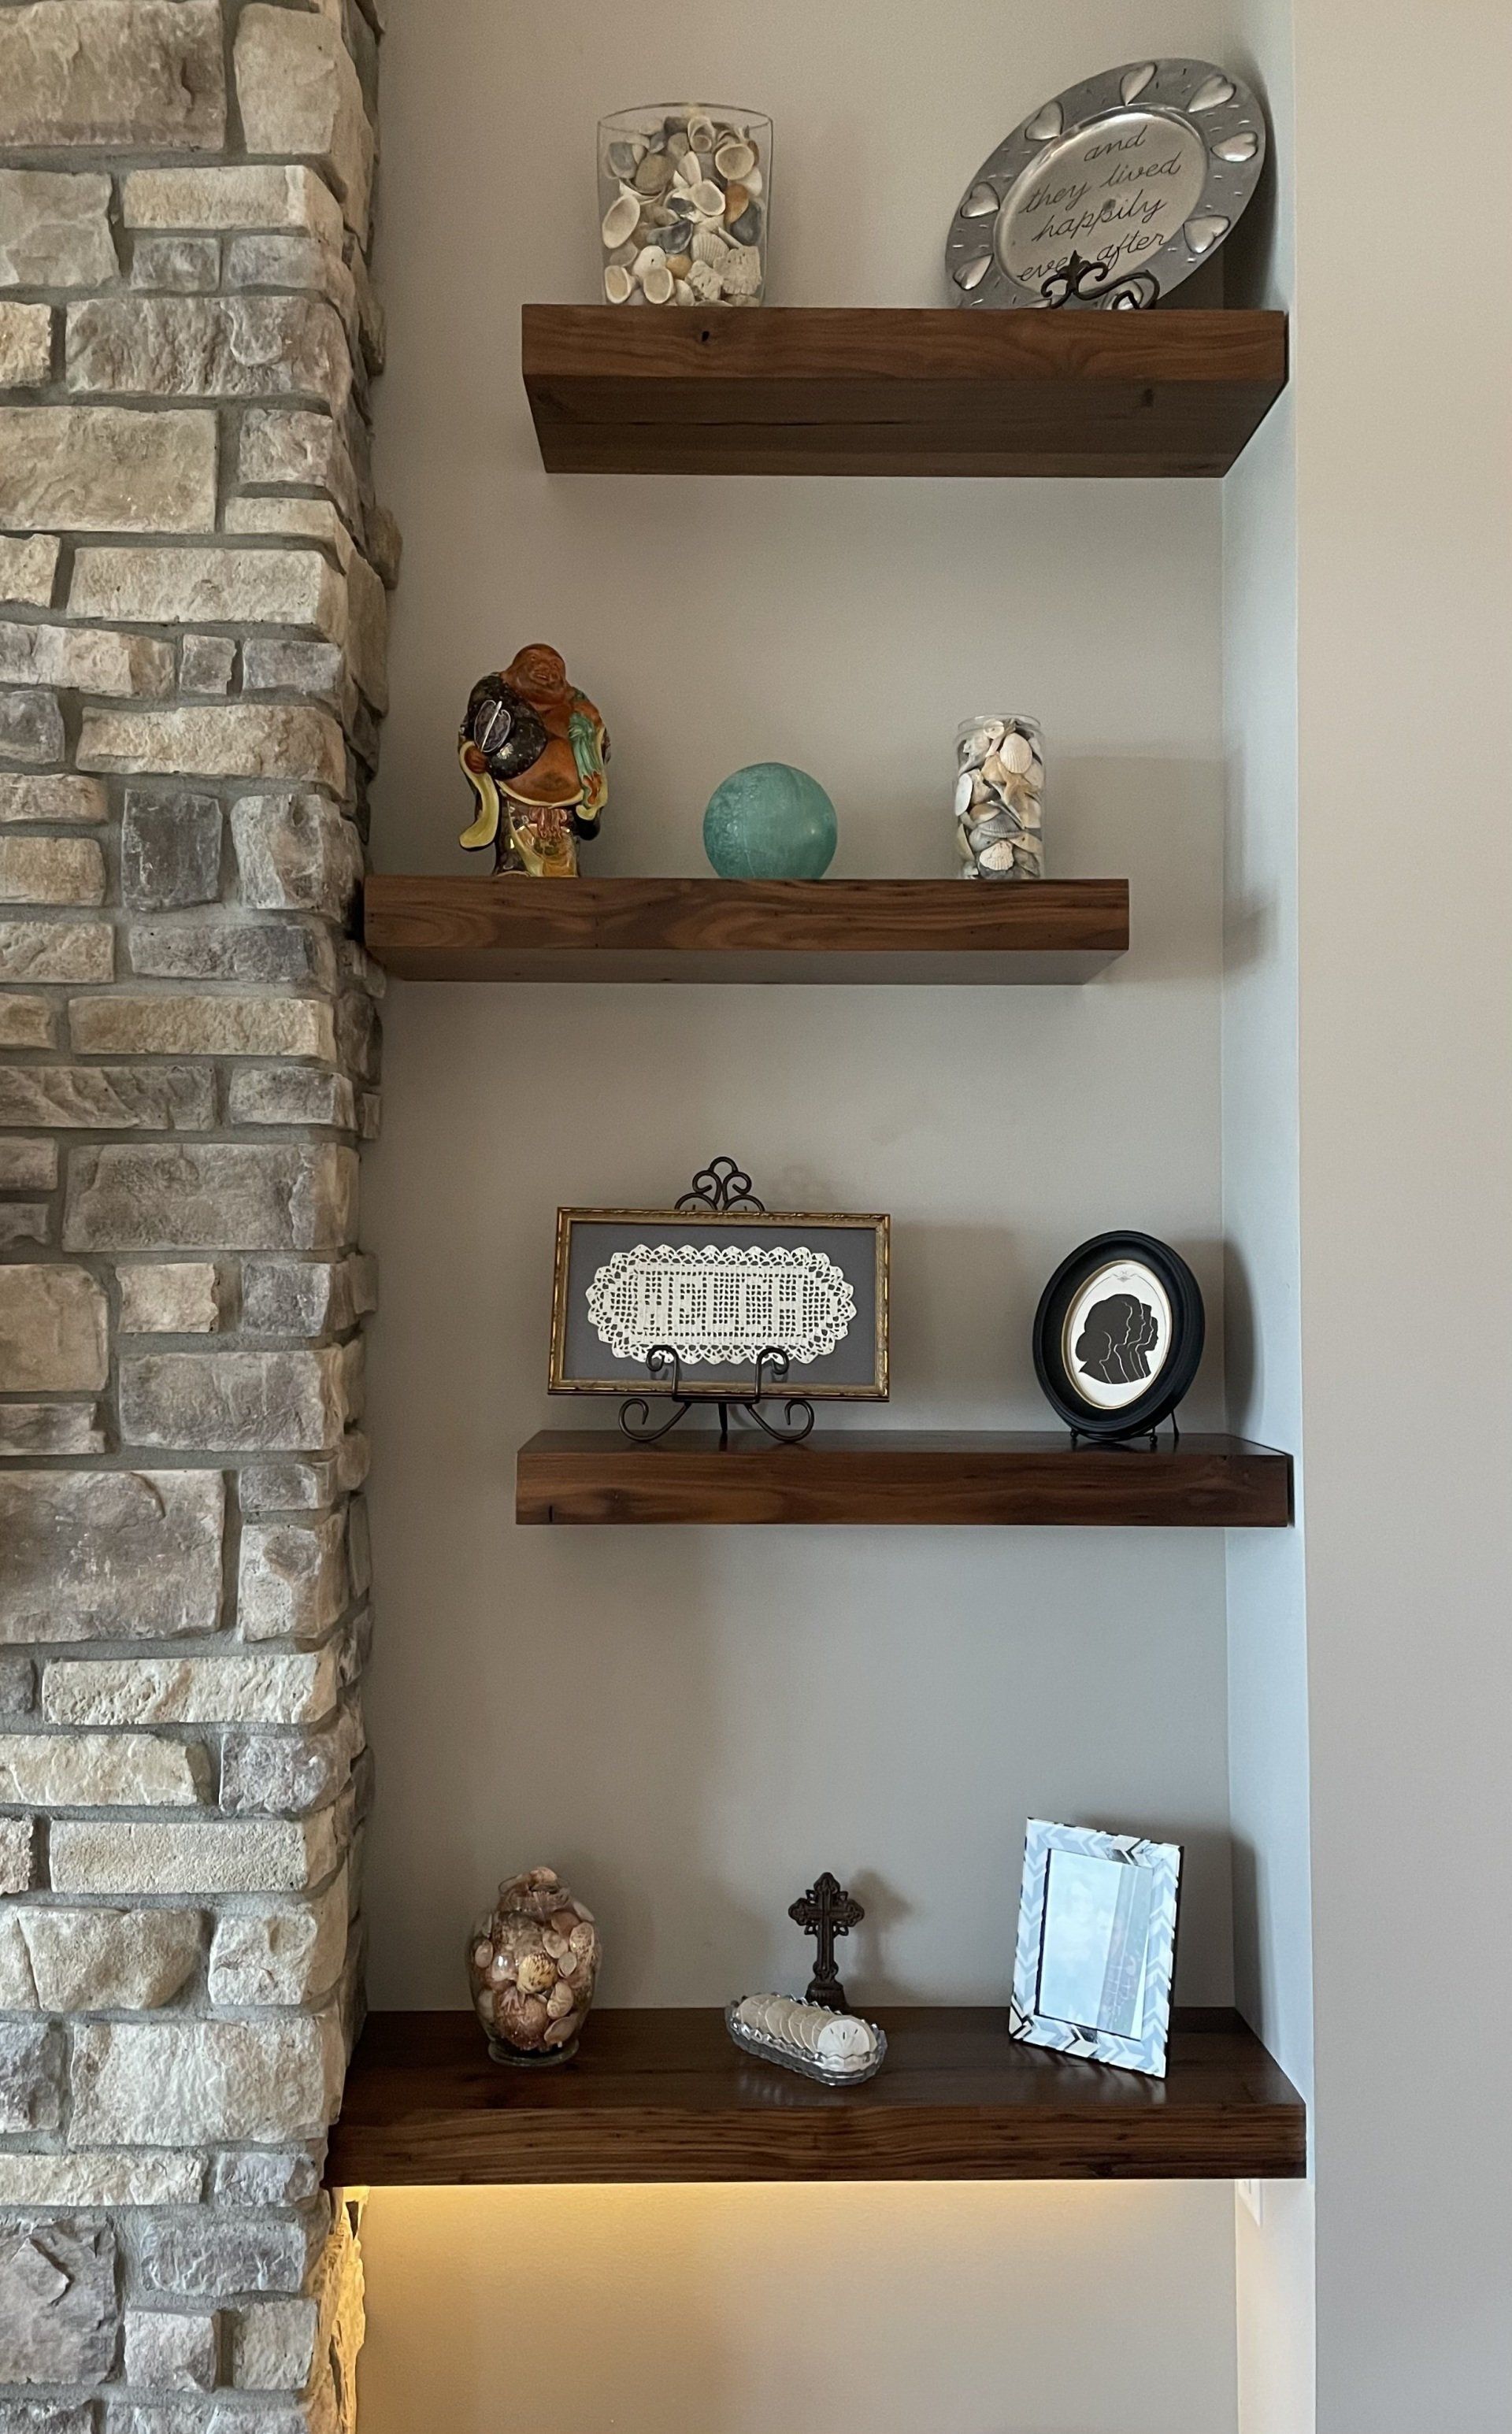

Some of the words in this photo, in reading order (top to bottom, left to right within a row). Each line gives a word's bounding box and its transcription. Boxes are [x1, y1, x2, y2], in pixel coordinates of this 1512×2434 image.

[1084, 124, 1148, 161] and
[1018, 182, 1091, 213] they
[1099, 151, 1182, 188] lived
[1031, 189, 1168, 242] happily
[1017, 256, 1081, 282] eve
[1096, 230, 1167, 272] after
[636, 1275, 803, 1335] WELCH
